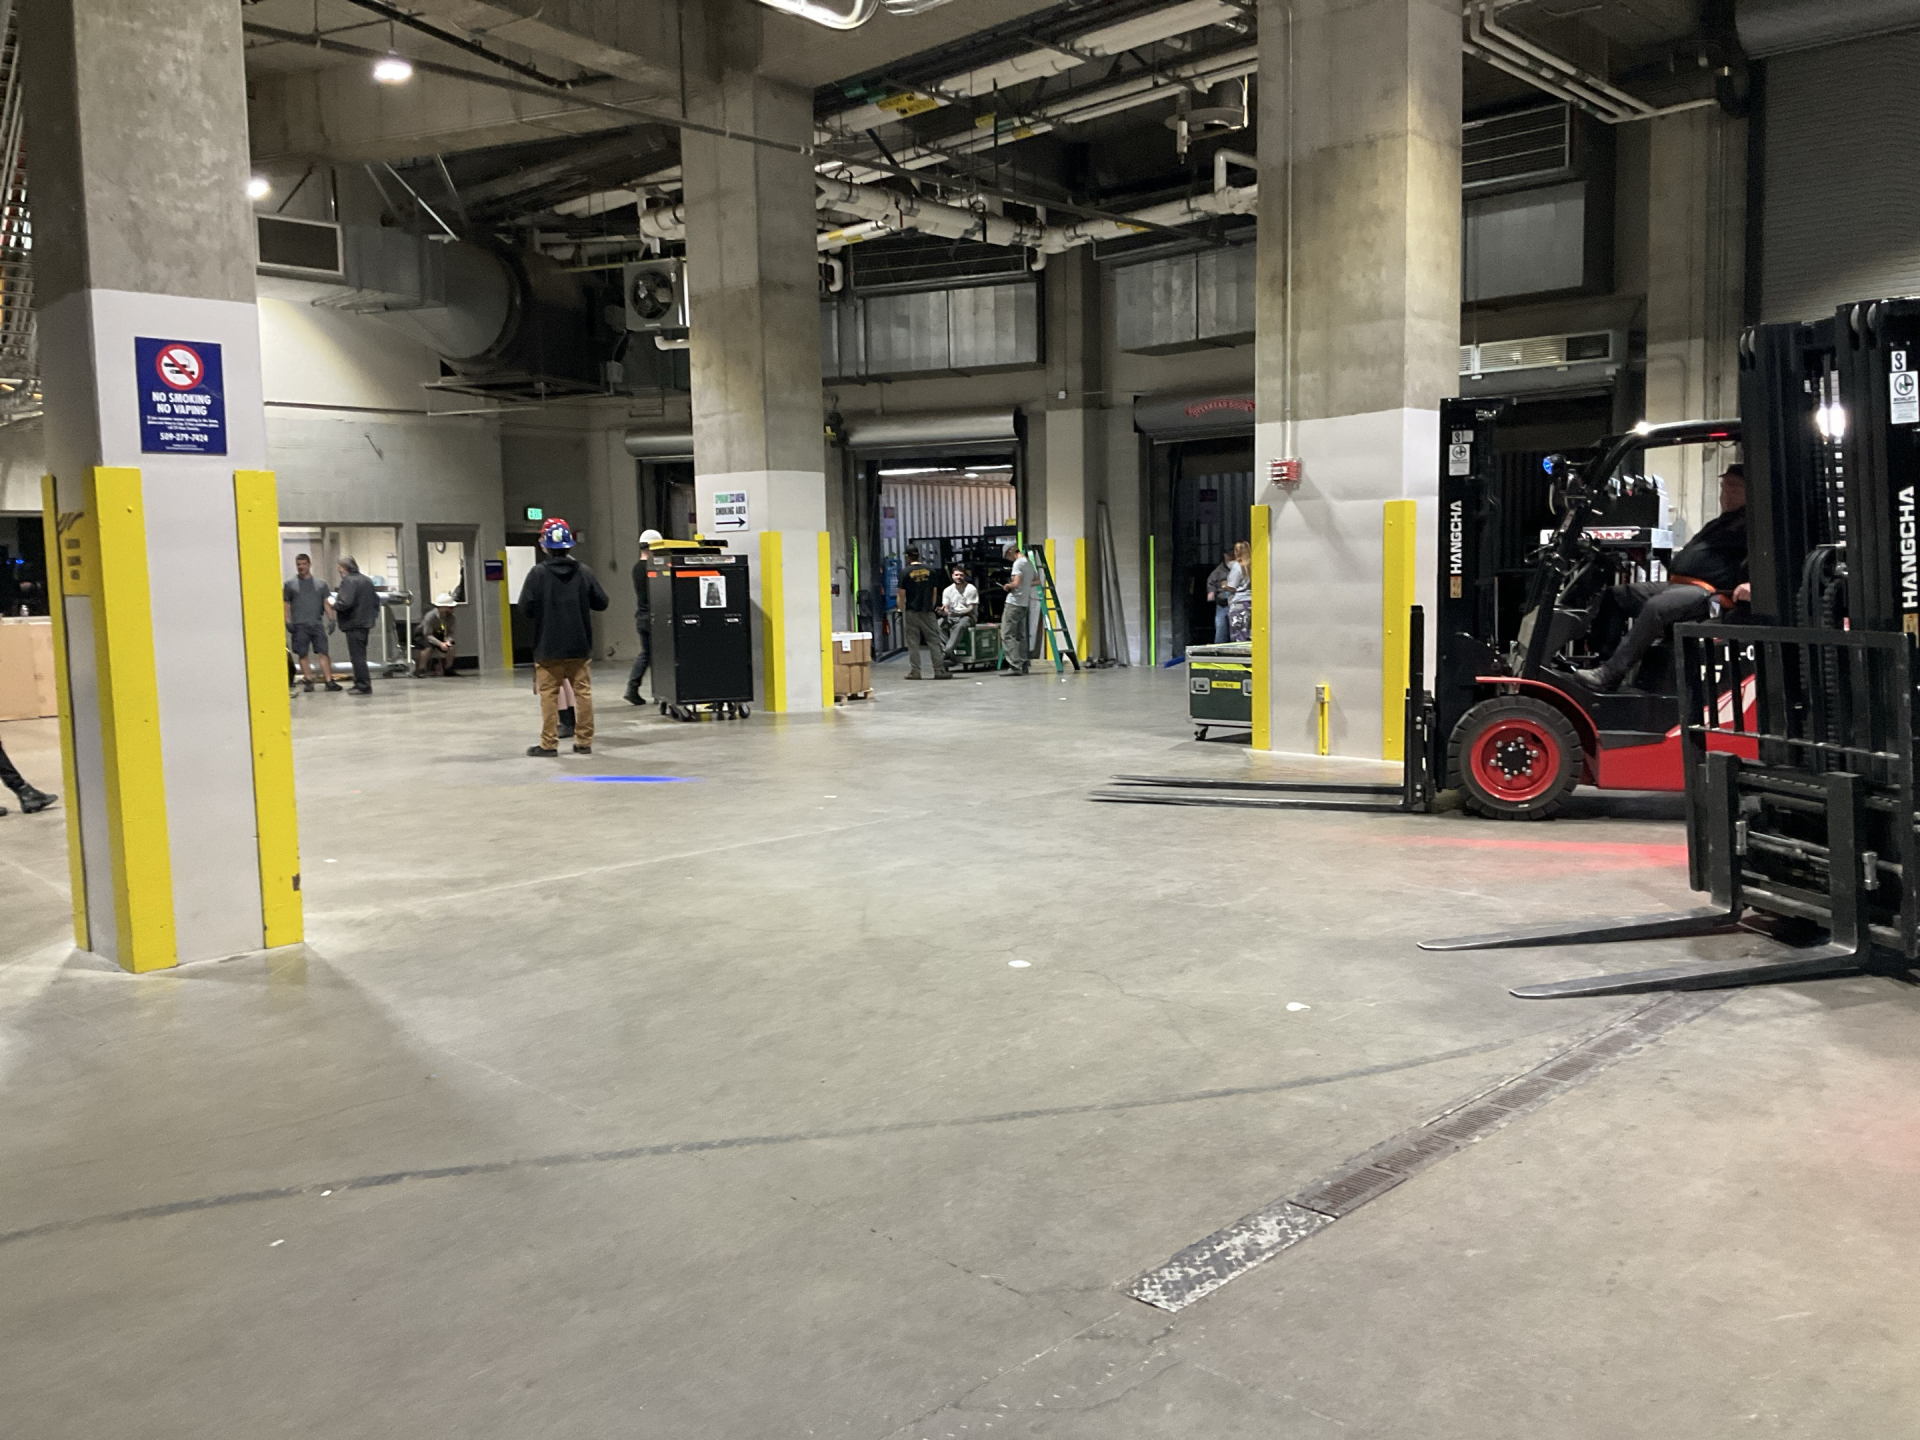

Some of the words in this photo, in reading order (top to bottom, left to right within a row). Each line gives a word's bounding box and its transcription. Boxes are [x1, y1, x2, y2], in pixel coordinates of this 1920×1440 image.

[151, 391, 166, 402] NO
[168, 393, 212, 405] SMOKING
[156, 403, 171, 414] NO
[173, 404, 208, 416] VAPING
[715, 507, 734, 515] SMOKING
[1450, 500, 1463, 575] HANGCHA
[1898, 485, 1919, 608] HANGCHA
